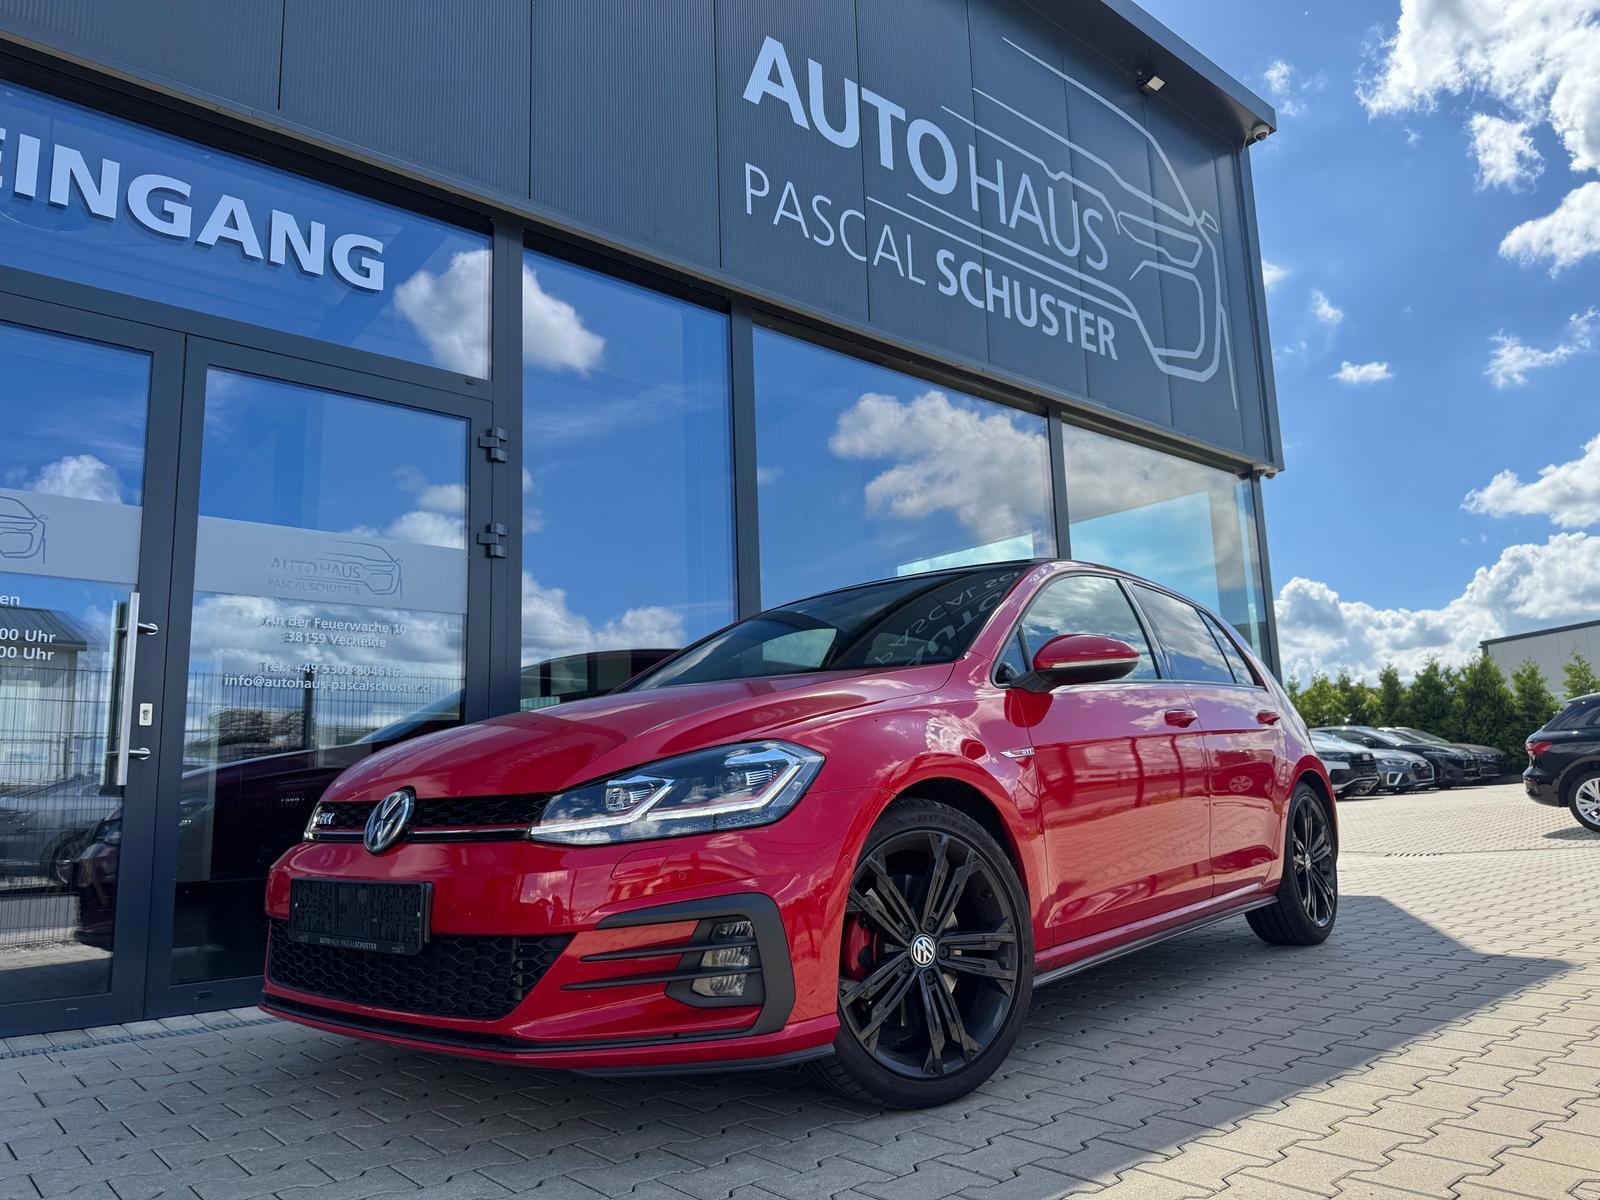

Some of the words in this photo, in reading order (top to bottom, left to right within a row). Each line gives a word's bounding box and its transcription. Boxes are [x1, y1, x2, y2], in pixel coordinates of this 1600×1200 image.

[743, 35, 1108, 271] AUTOHAUS
[0, 127, 385, 291] INGANG
[745, 162, 926, 286] PASCAL
[937, 248, 1118, 361] SCHUSTER
[288, 616, 311, 628] der
[314, 617, 389, 633] Feuerwache
[24, 629, 56, 643] Uhr
[287, 630, 327, 643] 38159
[329, 634, 387, 648] Vechelde
[23, 647, 55, 661] Uhr
[295, 663, 319, 675] +49
